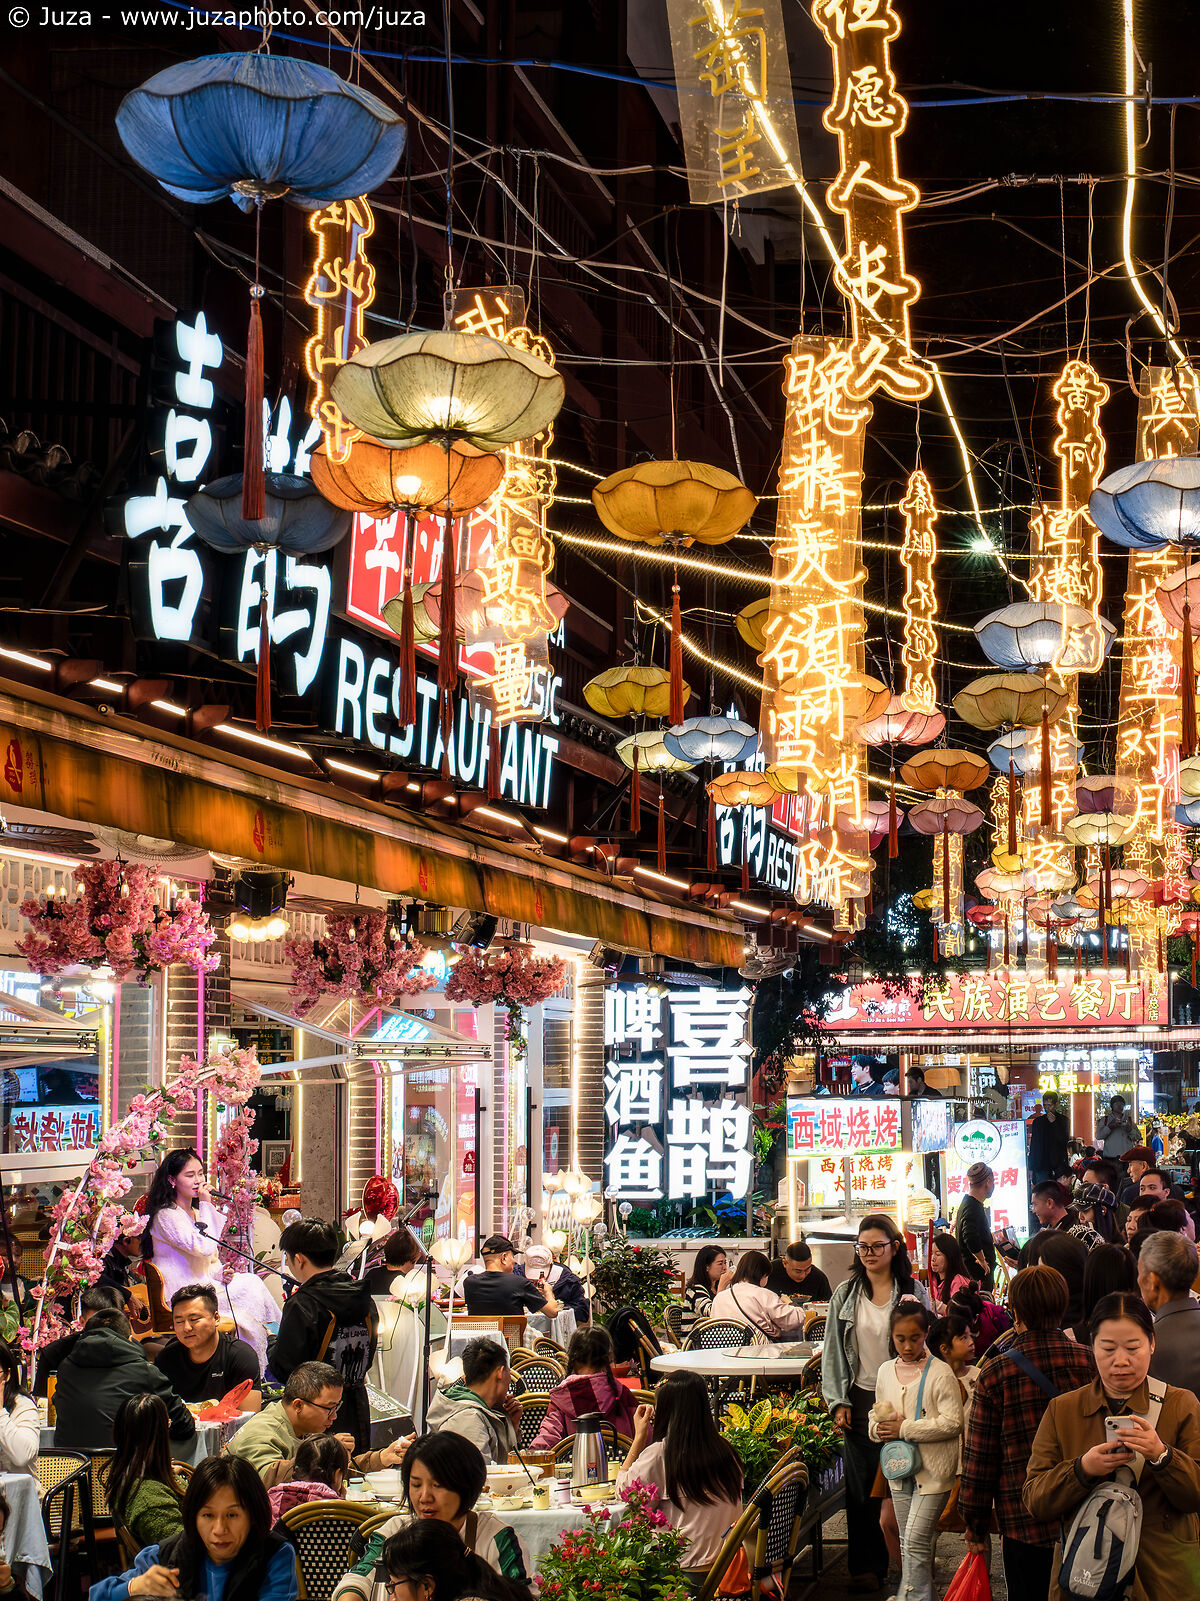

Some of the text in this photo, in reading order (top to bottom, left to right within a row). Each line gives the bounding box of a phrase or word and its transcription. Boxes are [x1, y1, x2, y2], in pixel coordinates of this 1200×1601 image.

[923, 978, 1141, 1023] 民族演艺餐厅
[1039, 1060, 1080, 1072] CRAFT
[603, 987, 664, 1199] 啤酒鱼
[667, 986, 755, 1200] 喜鹊
[1038, 1073, 1078, 1093] 外卖
[791, 1105, 899, 1150] 西域烧烤
[833, 1173, 886, 1192] 大排档
[1073, 1577, 1096, 1588] CAMEL
